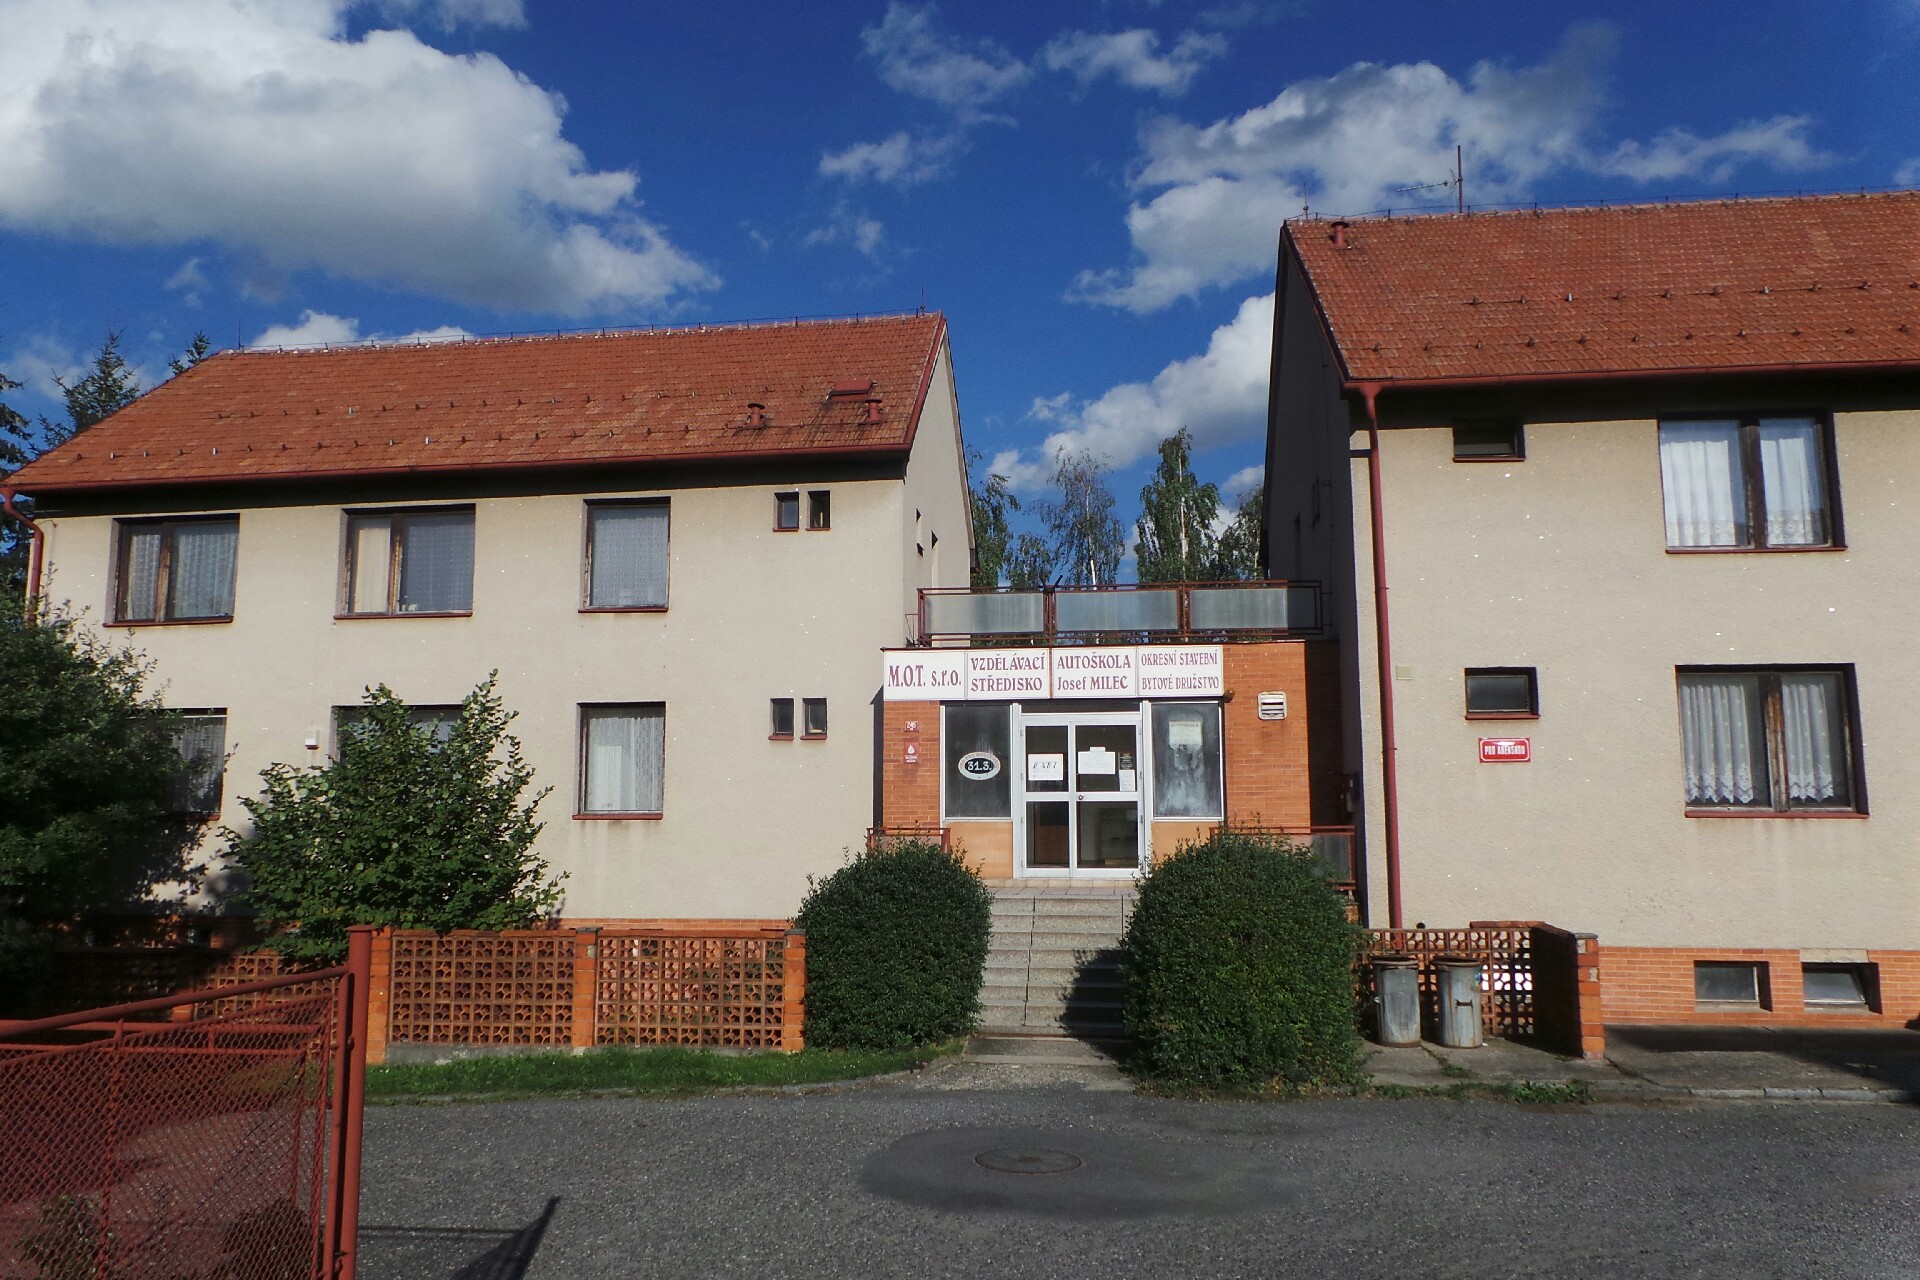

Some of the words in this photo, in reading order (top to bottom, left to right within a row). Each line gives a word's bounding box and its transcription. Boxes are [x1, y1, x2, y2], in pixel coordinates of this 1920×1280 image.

[971, 653, 1045, 671] VZDĚLÁVACÍ
[1057, 651, 1131, 669] AUTOŠKOLA
[1141, 650, 1177, 666] OKRESNÍ
[1180, 650, 1218, 665] STAVEBNÍ
[888, 665, 925, 687] M.O.T.
[931, 670, 961, 686] s.r.o.
[971, 675, 1042, 692] STŘEDISKO
[1057, 676, 1086, 690] Josef
[1091, 675, 1128, 690] MILEC
[1142, 674, 1173, 690] BYTOVÉ
[1176, 674, 1219, 690] DRUŽSTVO
